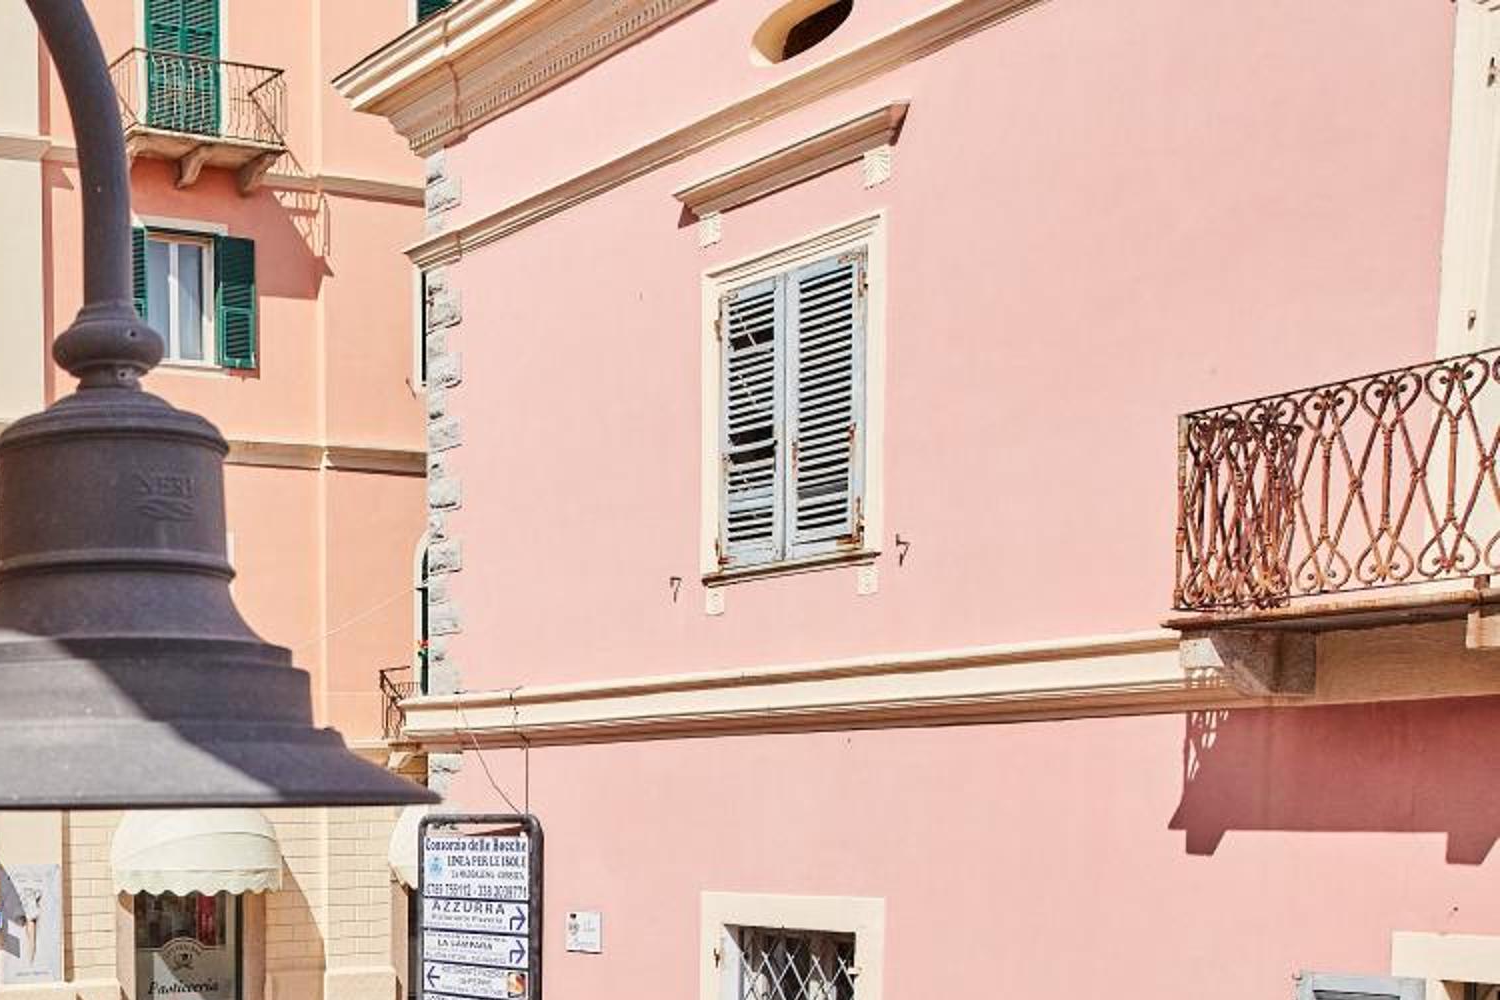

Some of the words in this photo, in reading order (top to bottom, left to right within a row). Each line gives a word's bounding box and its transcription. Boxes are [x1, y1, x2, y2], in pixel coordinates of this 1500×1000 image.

[426, 837, 466, 851] Consorzio
[468, 839, 490, 851] delle
[493, 838, 526, 851] Bocche
[447, 855, 471, 867] LINEA
[472, 855, 488, 867] PER
[431, 901, 505, 915] AZZURRA
[147, 977, 220, 995] Pasticceria
